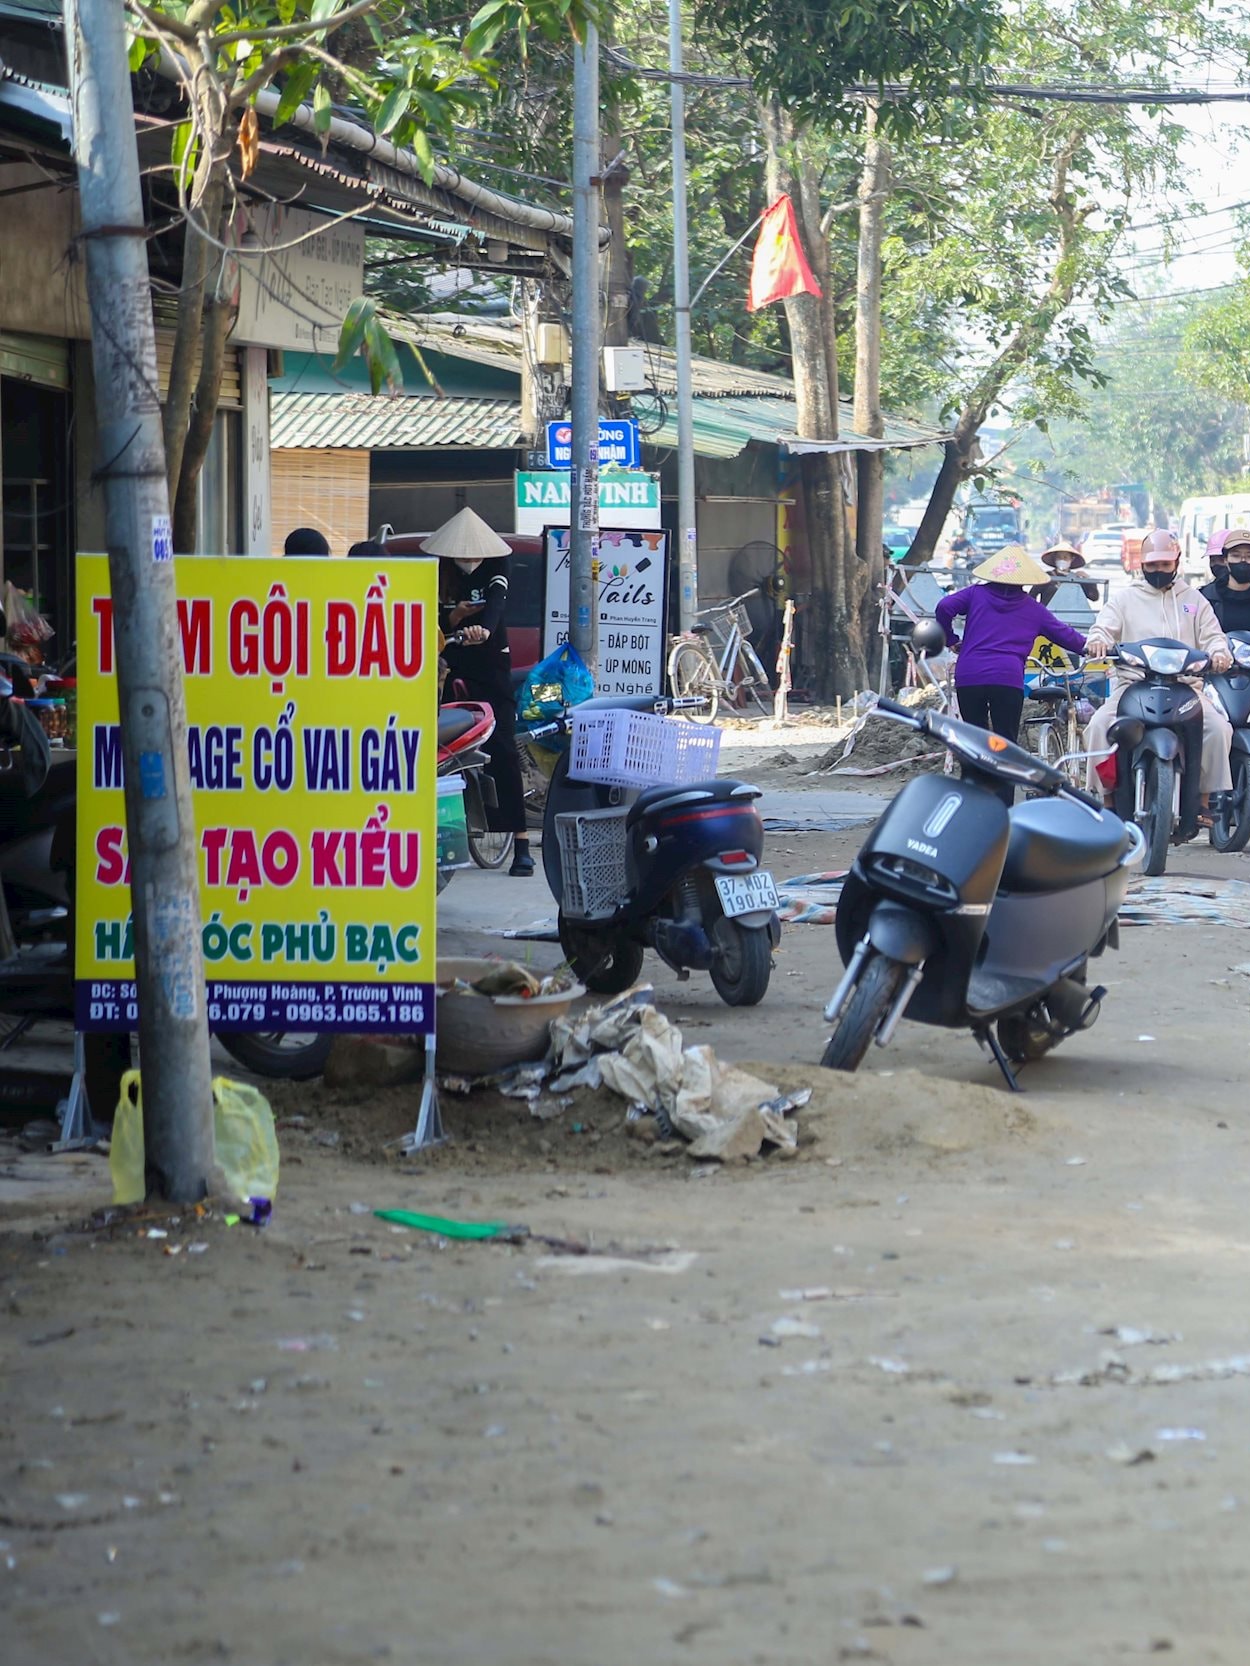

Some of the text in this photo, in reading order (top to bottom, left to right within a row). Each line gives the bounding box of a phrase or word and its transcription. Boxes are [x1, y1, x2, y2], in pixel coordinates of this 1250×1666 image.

[92, 575, 423, 693] TM GỘI ĐẦU
[253, 701, 296, 791] CỔ
[304, 728, 350, 790] VAI
[360, 715, 420, 792] GÁY
[201, 828, 299, 901] TẠO
[310, 805, 418, 888] KIỂU
[726, 891, 777, 913] 190.49
[202, 913, 252, 961] ÓC
[261, 910, 336, 961] PHỦ
[345, 924, 421, 973] BẠC
[90, 1002, 120, 1020] ĐT:
[286, 1003, 424, 1023] 0963.065.186
[214, 984, 267, 1003] Phượng
[324, 985, 336, 1000] P.
[340, 985, 388, 1003] Trường
[392, 985, 423, 1001] Vinh
